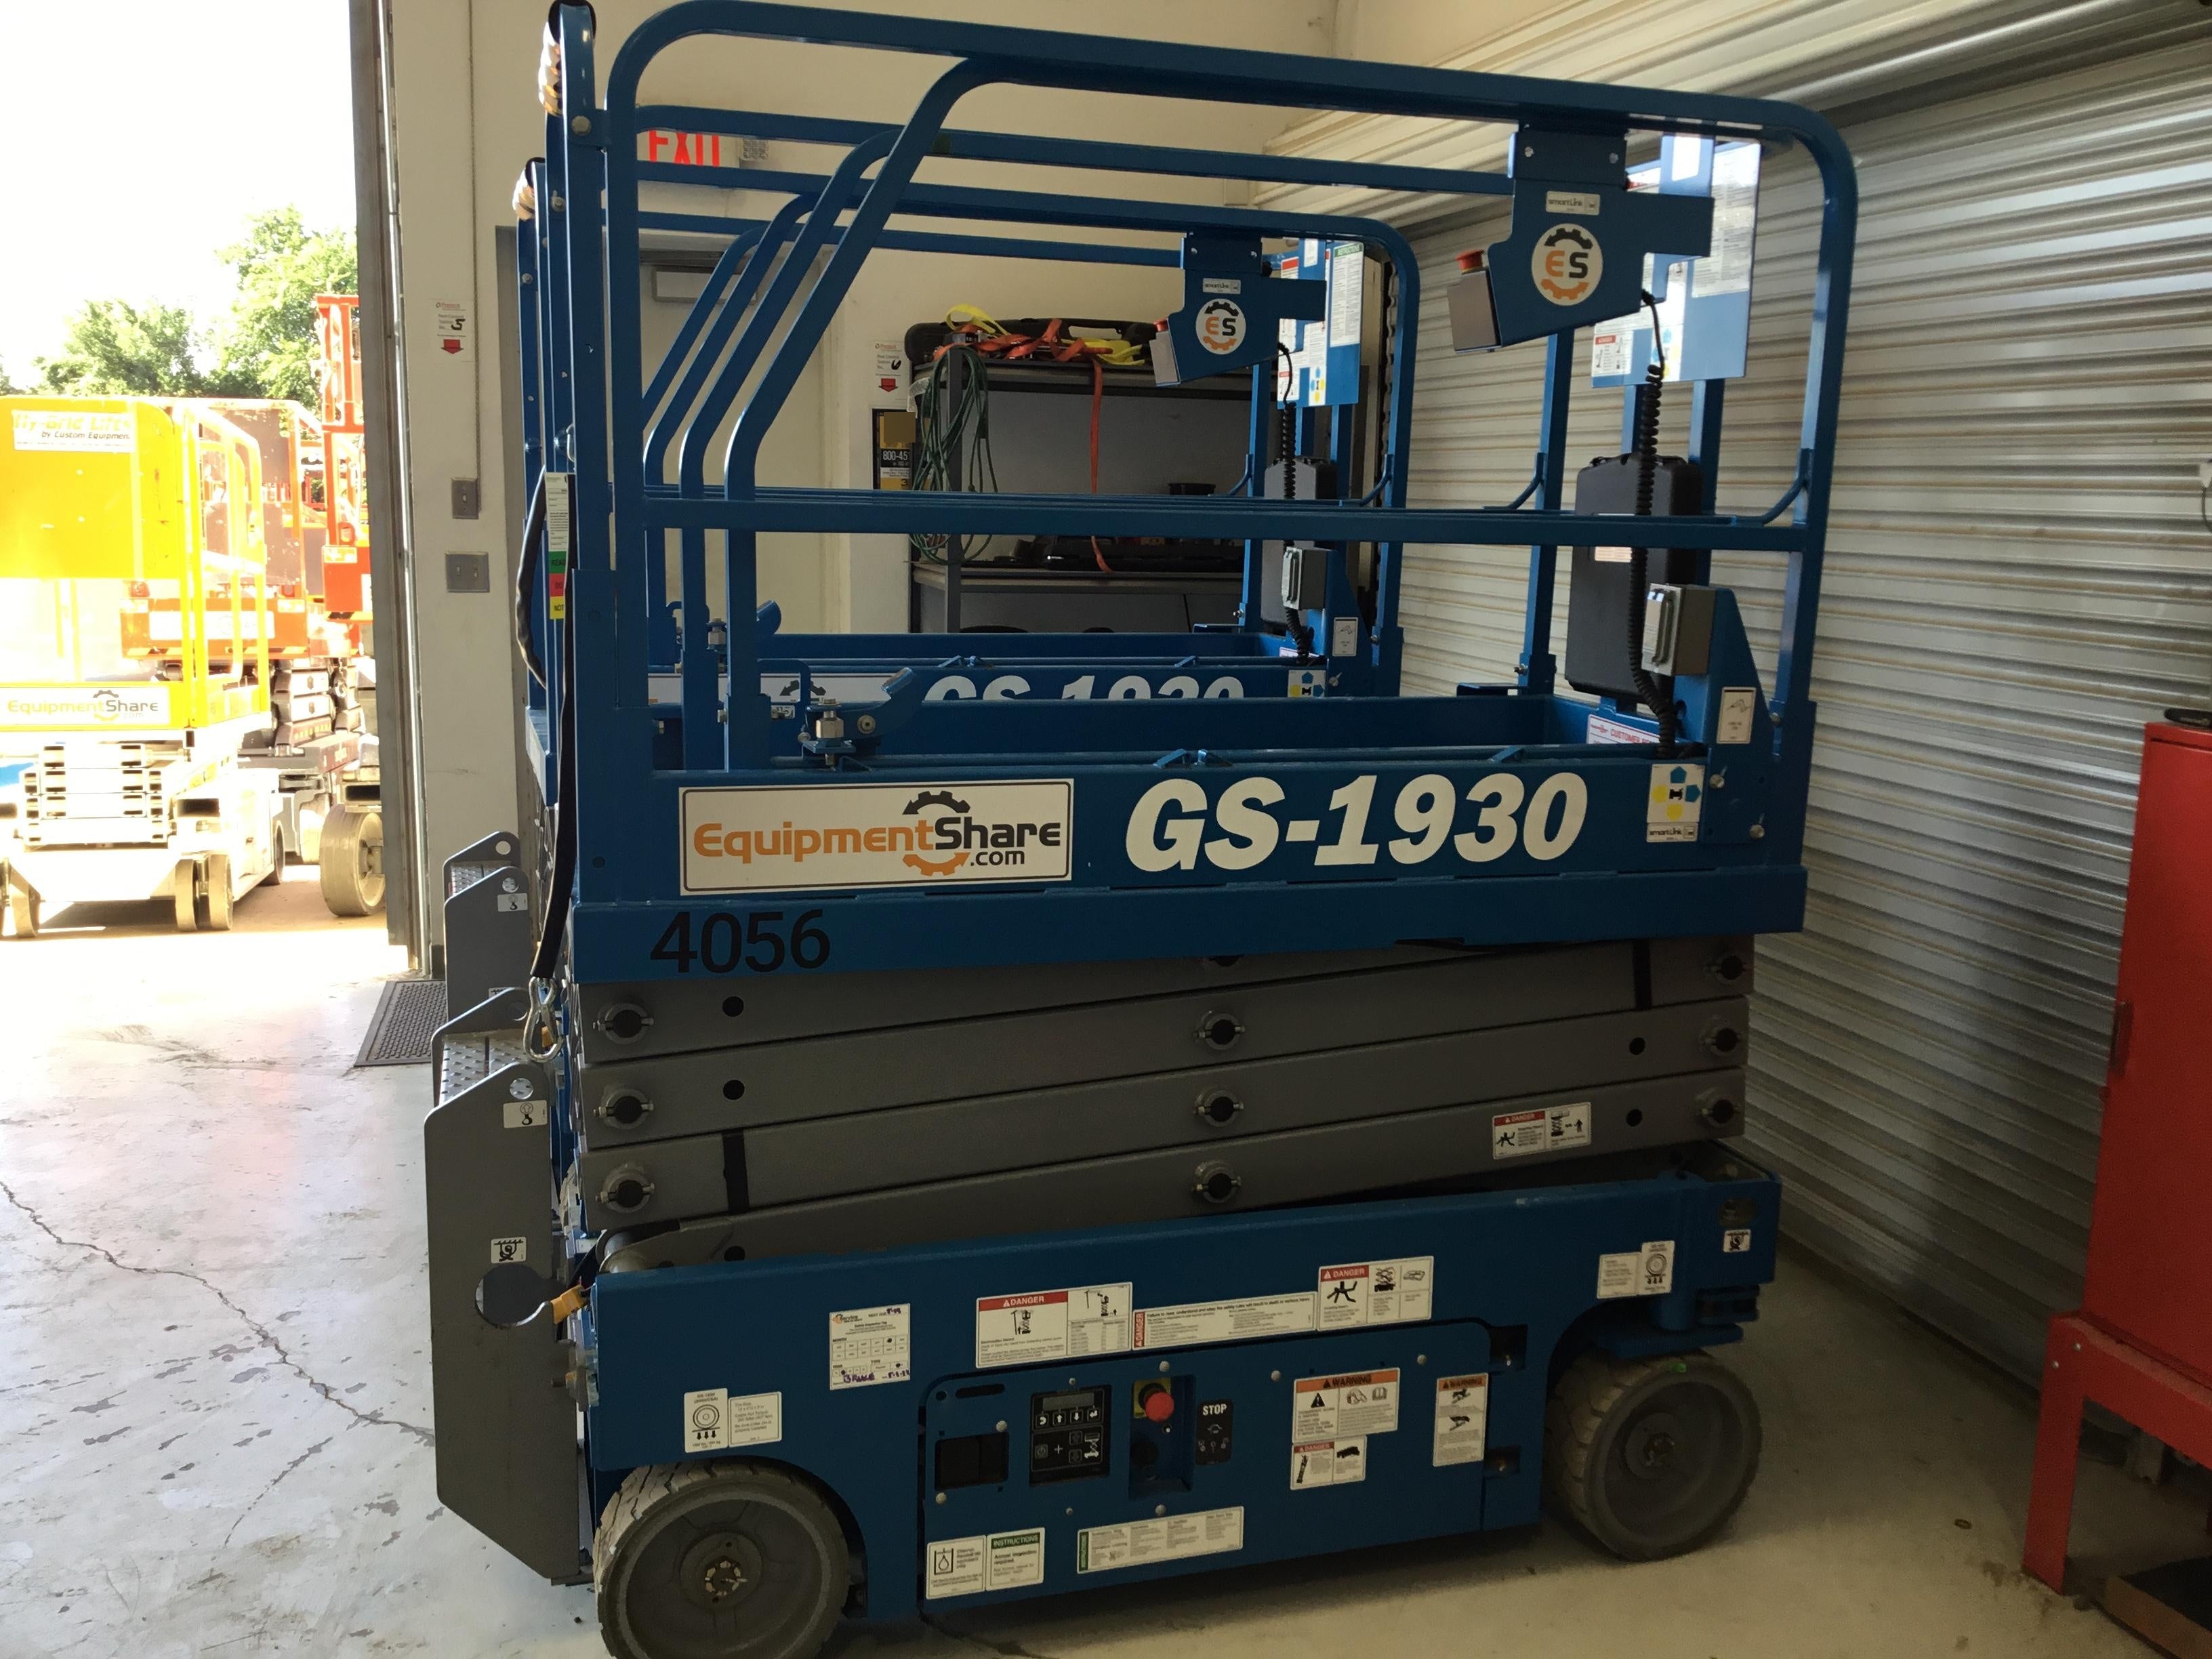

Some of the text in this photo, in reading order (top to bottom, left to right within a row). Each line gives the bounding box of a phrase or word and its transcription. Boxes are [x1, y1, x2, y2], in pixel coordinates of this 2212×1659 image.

[1544, 250, 1589, 279] ES
[1205, 316, 1237, 337] ES
[54, 430, 85, 438] Custom
[7, 699, 159, 716] EquipmentShare
[1125, 771, 1589, 873] GS-1930
[693, 815, 1061, 865] EquipmentShare
[970, 851, 1025, 867] .com
[650, 909, 831, 975] 4056
[1333, 1268, 1366, 1278] DANGER
[1010, 1295, 1045, 1306] DANGER
[1136, 1313, 1144, 1341] DANGER
[1332, 1374, 1372, 1387] WARNING
[1449, 1378, 1483, 1388] WARNING
[1202, 1404, 1227, 1416] STOP
[993, 1534, 1038, 1547] INSTRUCTIONS
